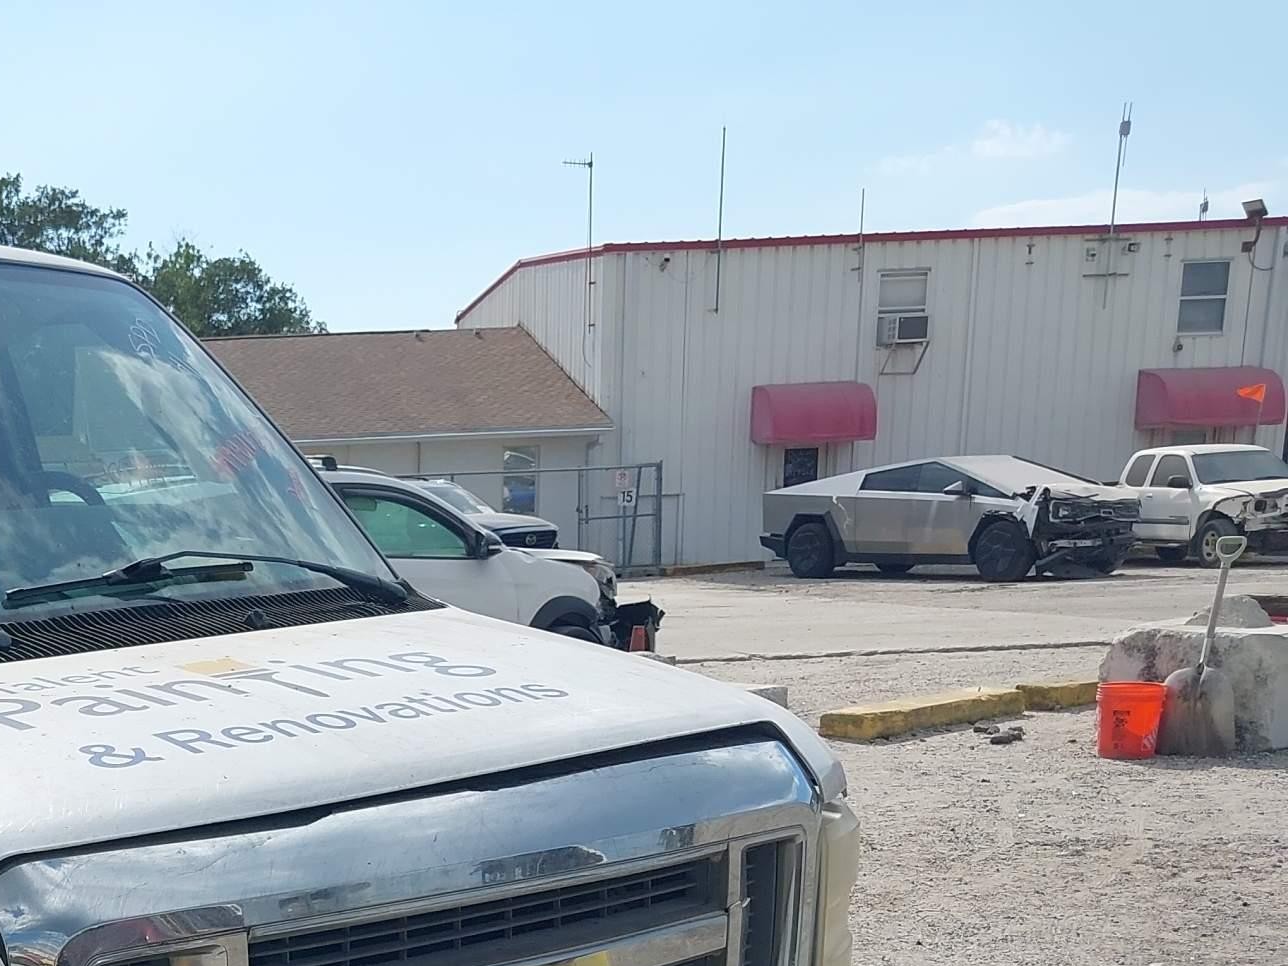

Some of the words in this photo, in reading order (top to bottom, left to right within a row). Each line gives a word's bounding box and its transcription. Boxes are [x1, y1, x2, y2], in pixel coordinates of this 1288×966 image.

[621, 490, 633, 503] 15
[77, 742, 163, 769] &
[152, 680, 569, 756] Renovations
